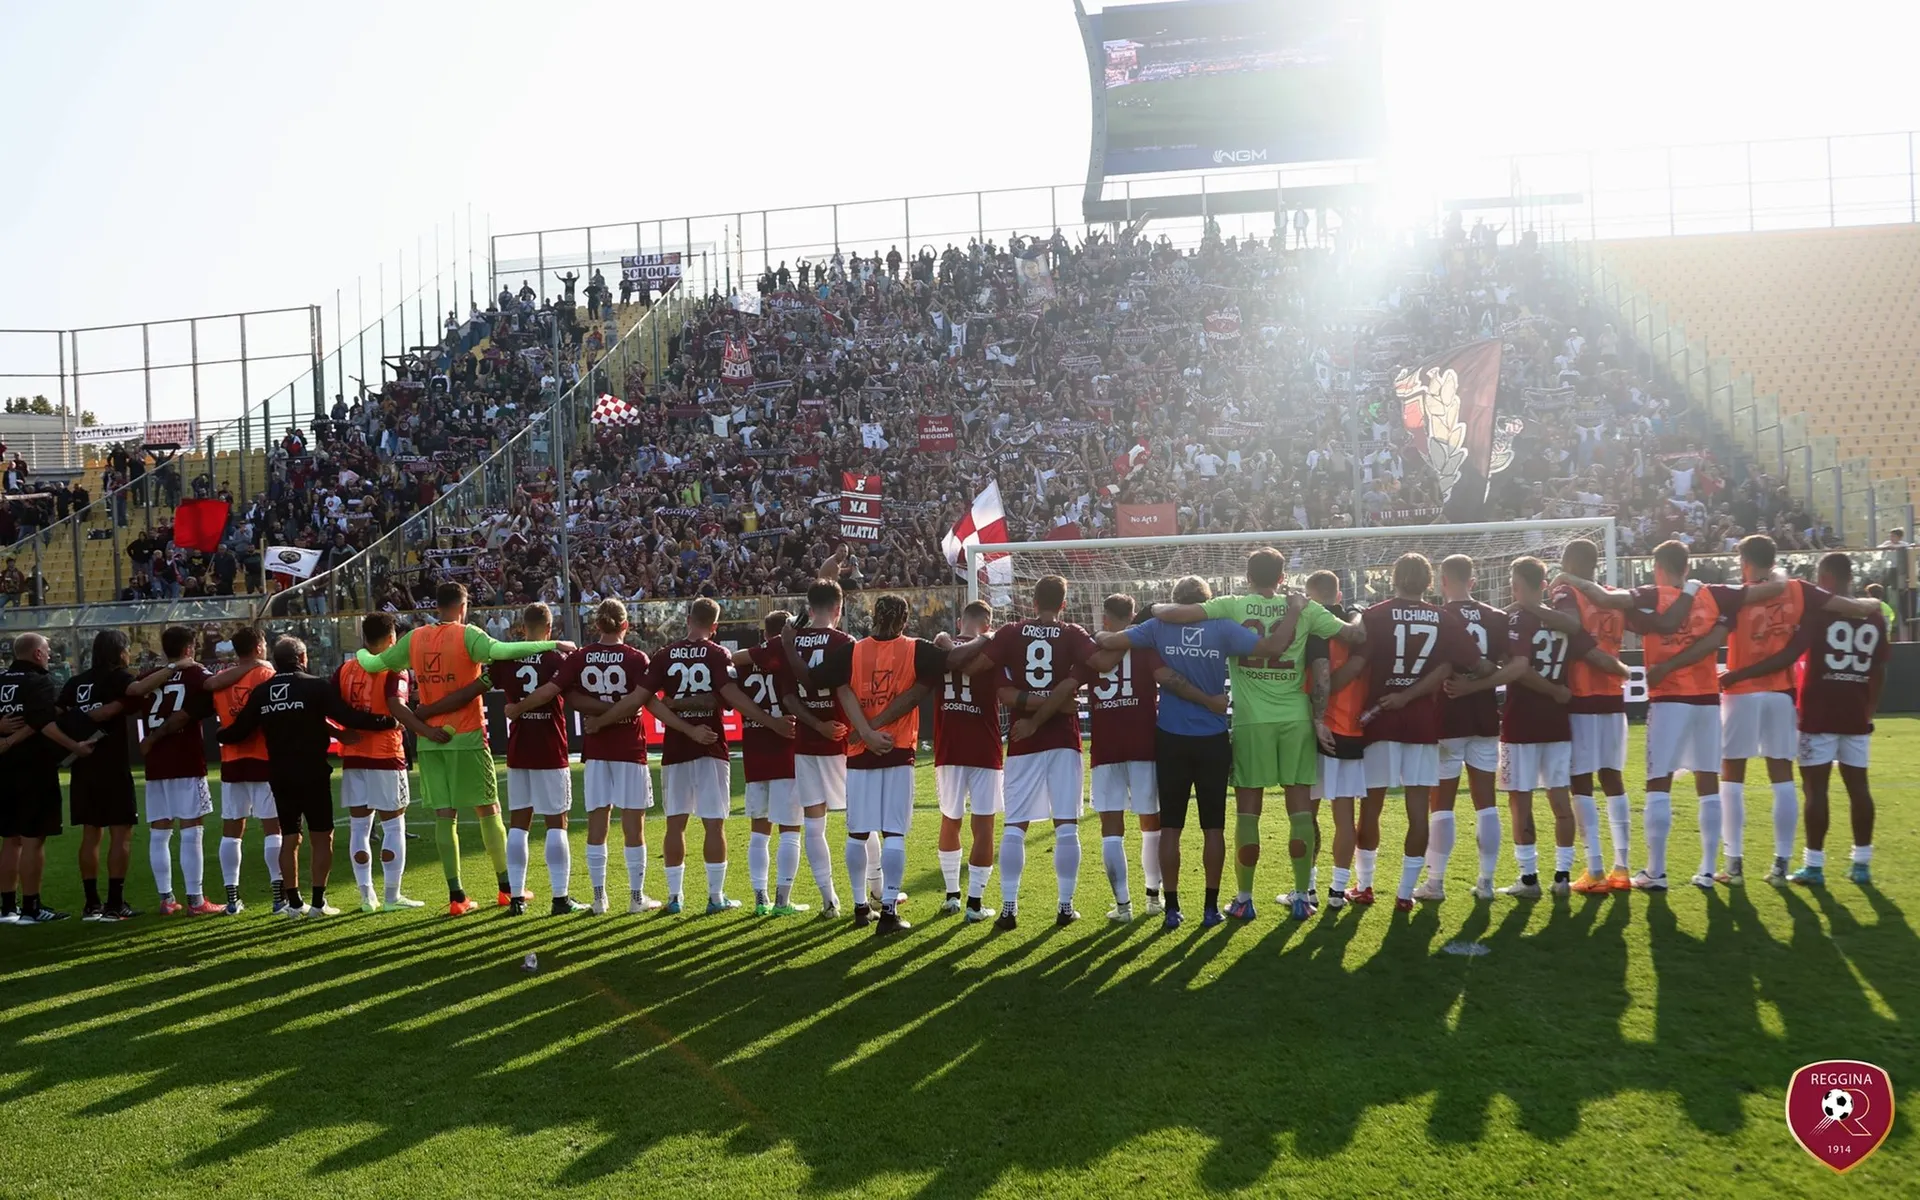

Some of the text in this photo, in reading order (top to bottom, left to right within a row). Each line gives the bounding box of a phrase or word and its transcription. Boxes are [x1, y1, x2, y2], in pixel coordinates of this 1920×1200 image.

[1213, 148, 1267, 163] NGM
[920, 432, 954, 440] REGGINI
[923, 425, 949, 433] SIAMO
[1022, 624, 1060, 638] CRISETIG
[1392, 608, 1439, 623] DI CHIARA
[586, 652, 624, 664] GIRAUDO
[1026, 639, 1052, 688] 8
[1165, 646, 1220, 659] GIVOVA
[1393, 624, 1438, 674] 17
[1532, 630, 1568, 679] 37
[1825, 621, 1879, 672] 99
[516, 665, 538, 701] 3
[667, 662, 712, 700] 28
[1093, 648, 1133, 699] 31
[145, 684, 186, 728] 27
[261, 702, 304, 714] GIVOVA
[744, 674, 783, 718] 21
